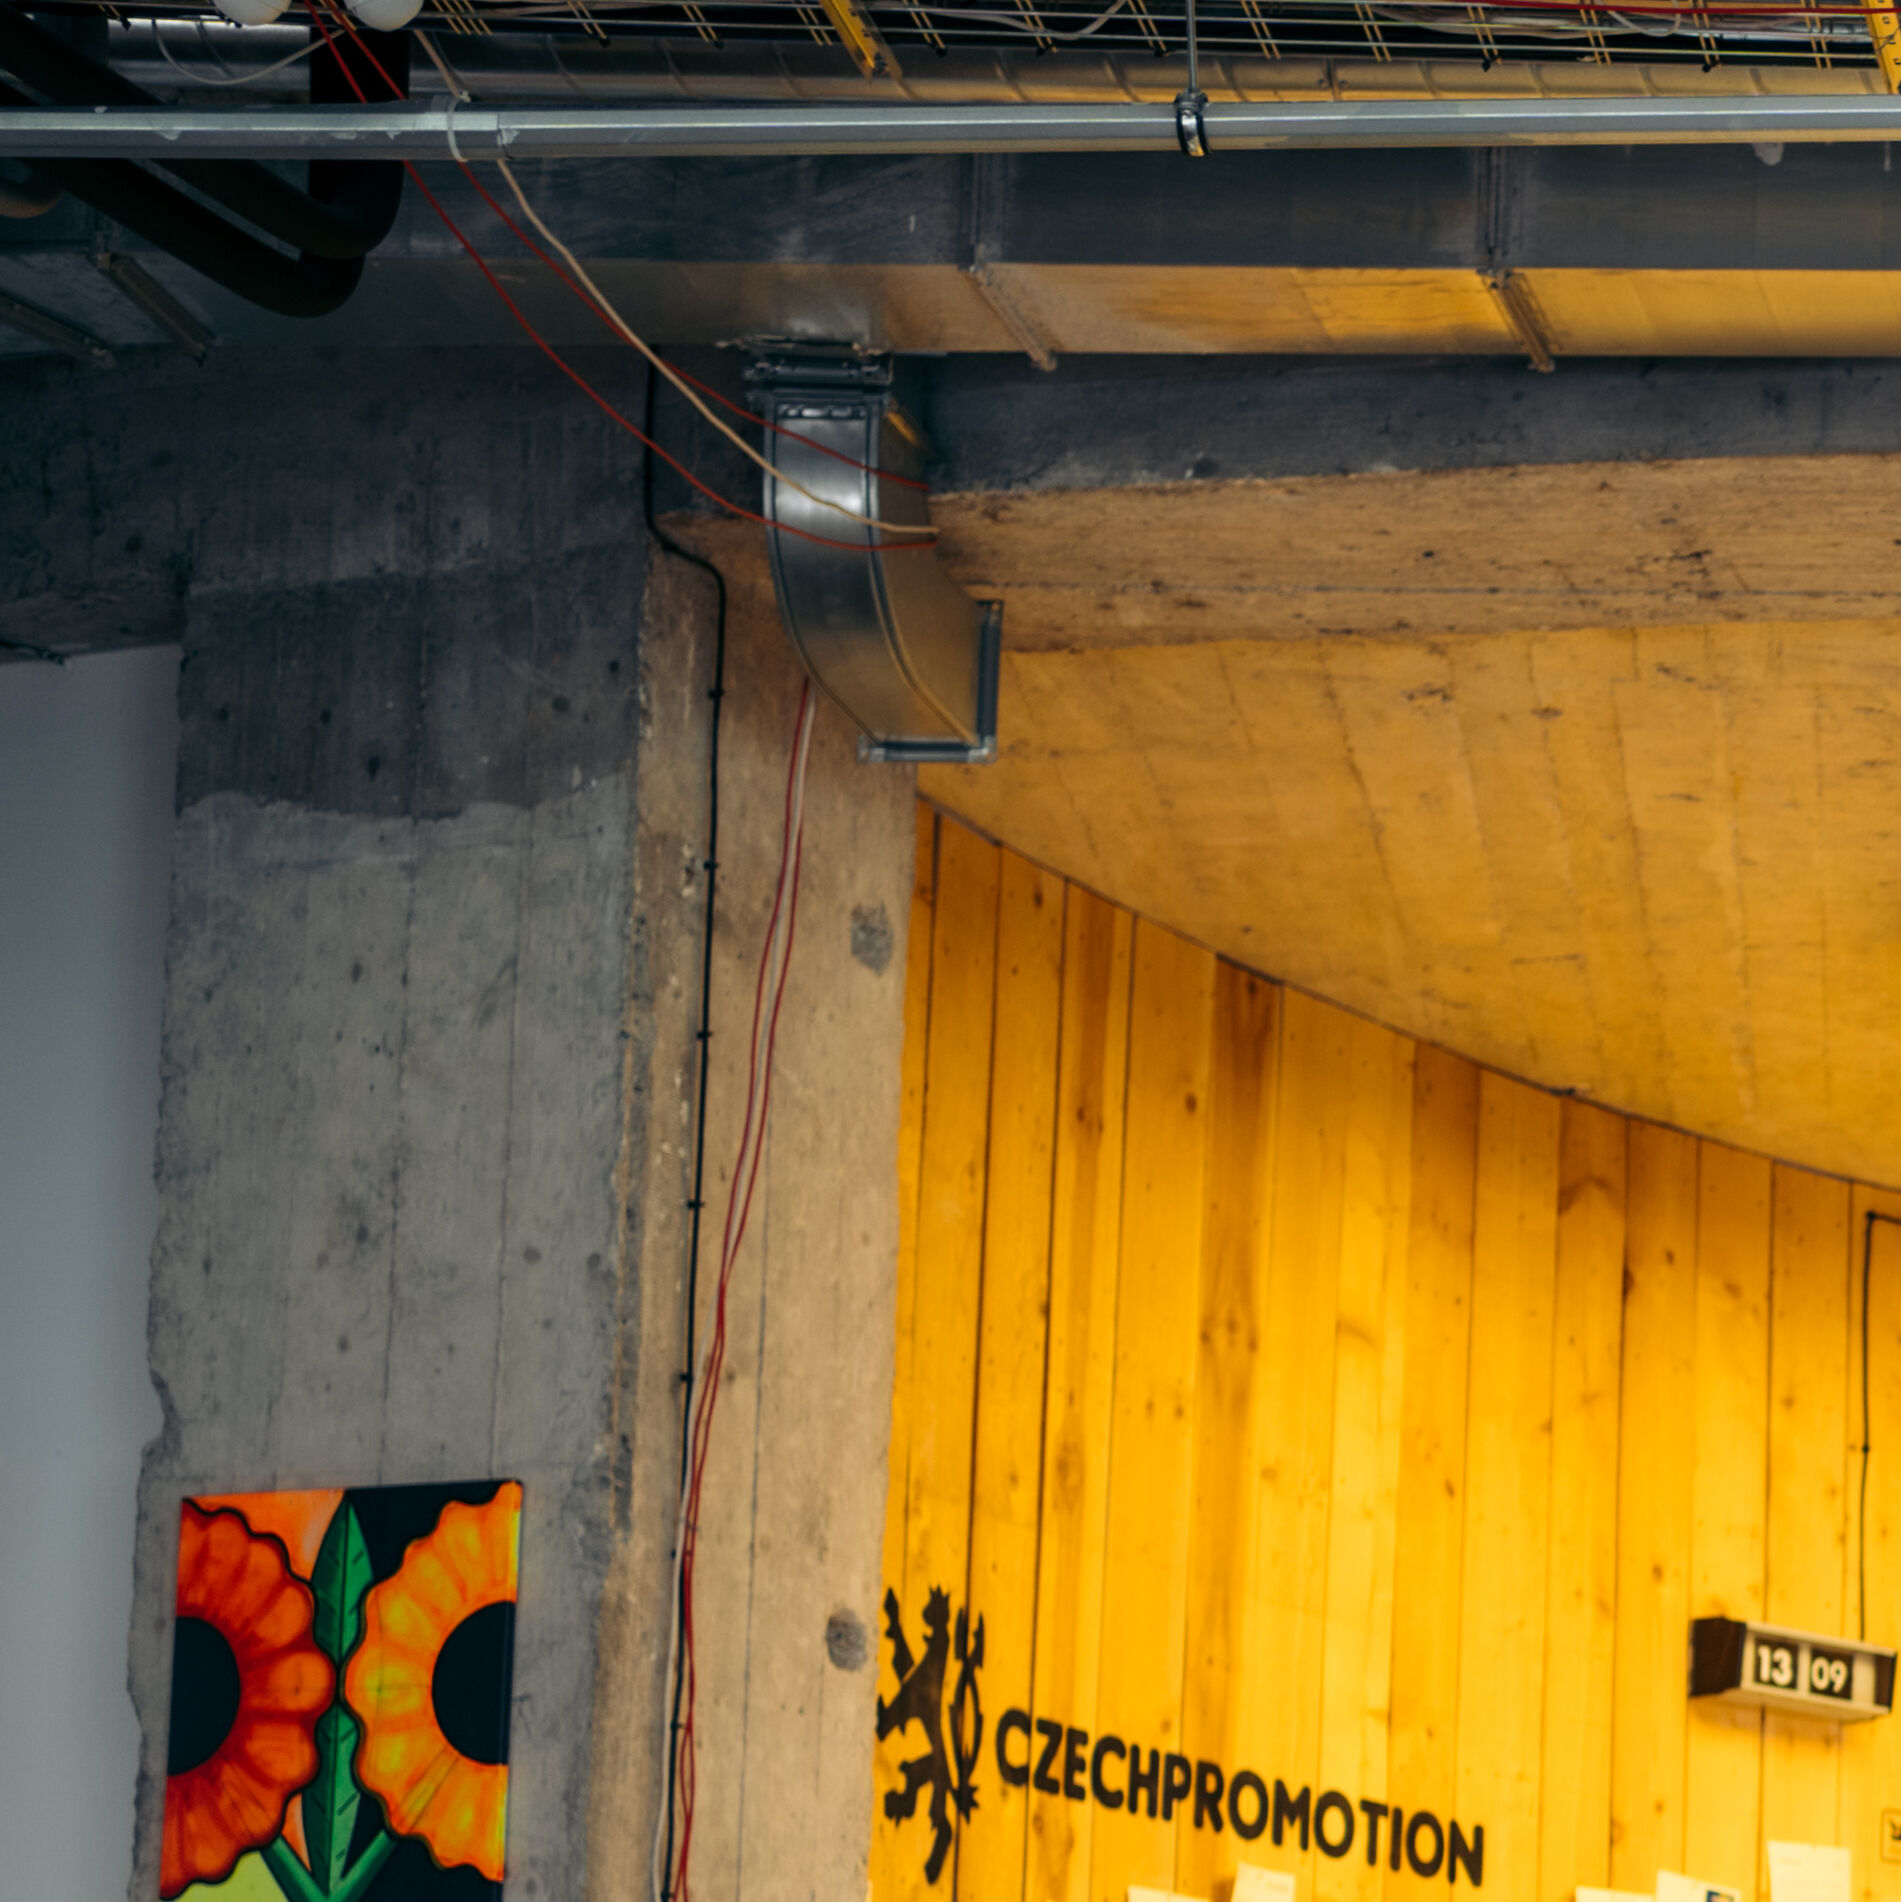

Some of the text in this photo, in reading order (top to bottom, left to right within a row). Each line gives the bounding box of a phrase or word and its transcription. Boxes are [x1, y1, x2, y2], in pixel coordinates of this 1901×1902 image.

[1757, 1643, 1848, 1694] 13 09
[996, 1709, 1484, 1887] CZECHPROMOTION
